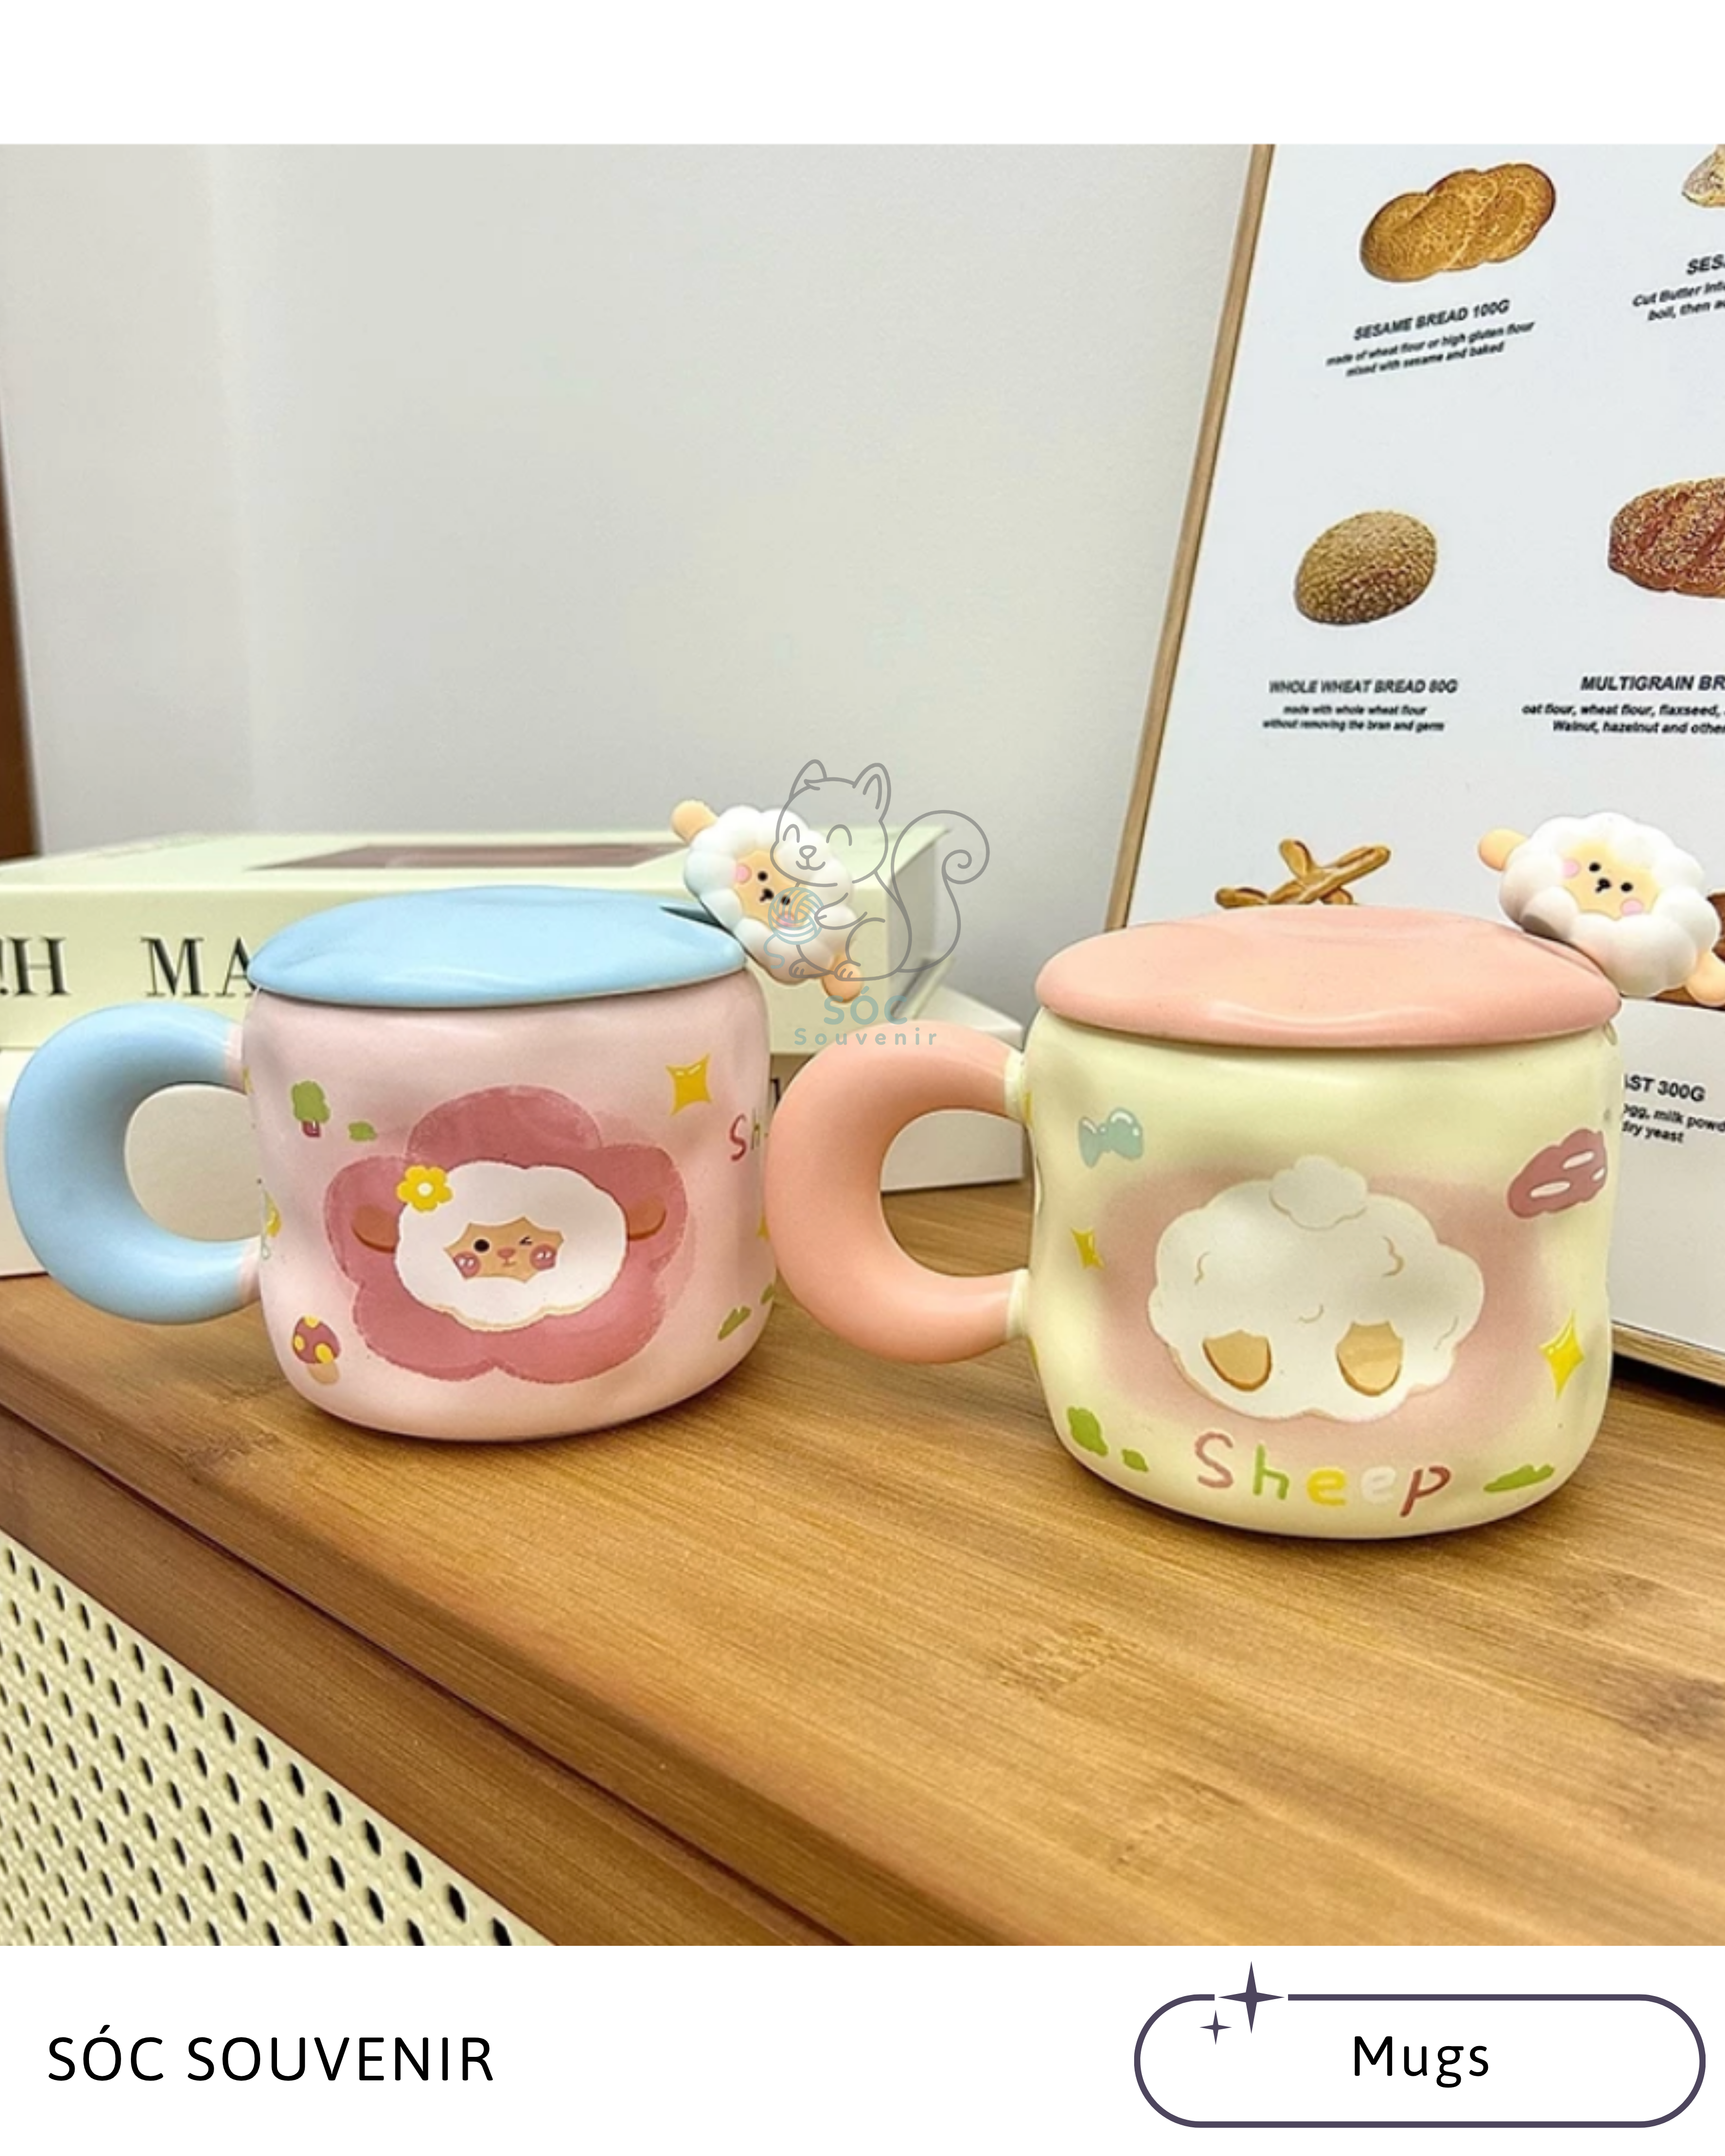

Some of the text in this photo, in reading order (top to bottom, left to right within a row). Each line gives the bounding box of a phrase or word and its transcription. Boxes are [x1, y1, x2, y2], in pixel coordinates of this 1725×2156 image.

[1686, 253, 1725, 275] SES
[1632, 292, 1658, 307] Cut
[1660, 286, 1702, 303] Butter
[1354, 299, 1510, 340] SESAME BREAD 100G
[1326, 321, 1535, 365] made of wheat flour or high gluten flour
[1346, 341, 1504, 377] mixed with sesame and baked
[1269, 680, 1318, 693] WHOLE
[1321, 680, 1372, 693] WHEAT
[1374, 680, 1425, 693] BREAD
[1581, 676, 1694, 690] MULTIGRAIN
[1283, 704, 1428, 715] made with whole wheat flour
[1522, 703, 1720, 718] oat flour, wheat flour, flaxseed,
[1262, 718, 1299, 729] without
[1301, 719, 1346, 732] removing
[1348, 719, 1364, 730] the
[1367, 720, 1391, 730] bran
[1394, 720, 1414, 731] and
[1553, 720, 1599, 734] Walnut,
[1603, 722, 1660, 733] hazelnut
[1662, 722, 1688, 733] and
[1658, 1080, 1706, 1102] 300G
[1653, 1109, 1685, 1124] milk
[1645, 1127, 1685, 1144] yeast
[1194, 1431, 1452, 1518] Sheep
